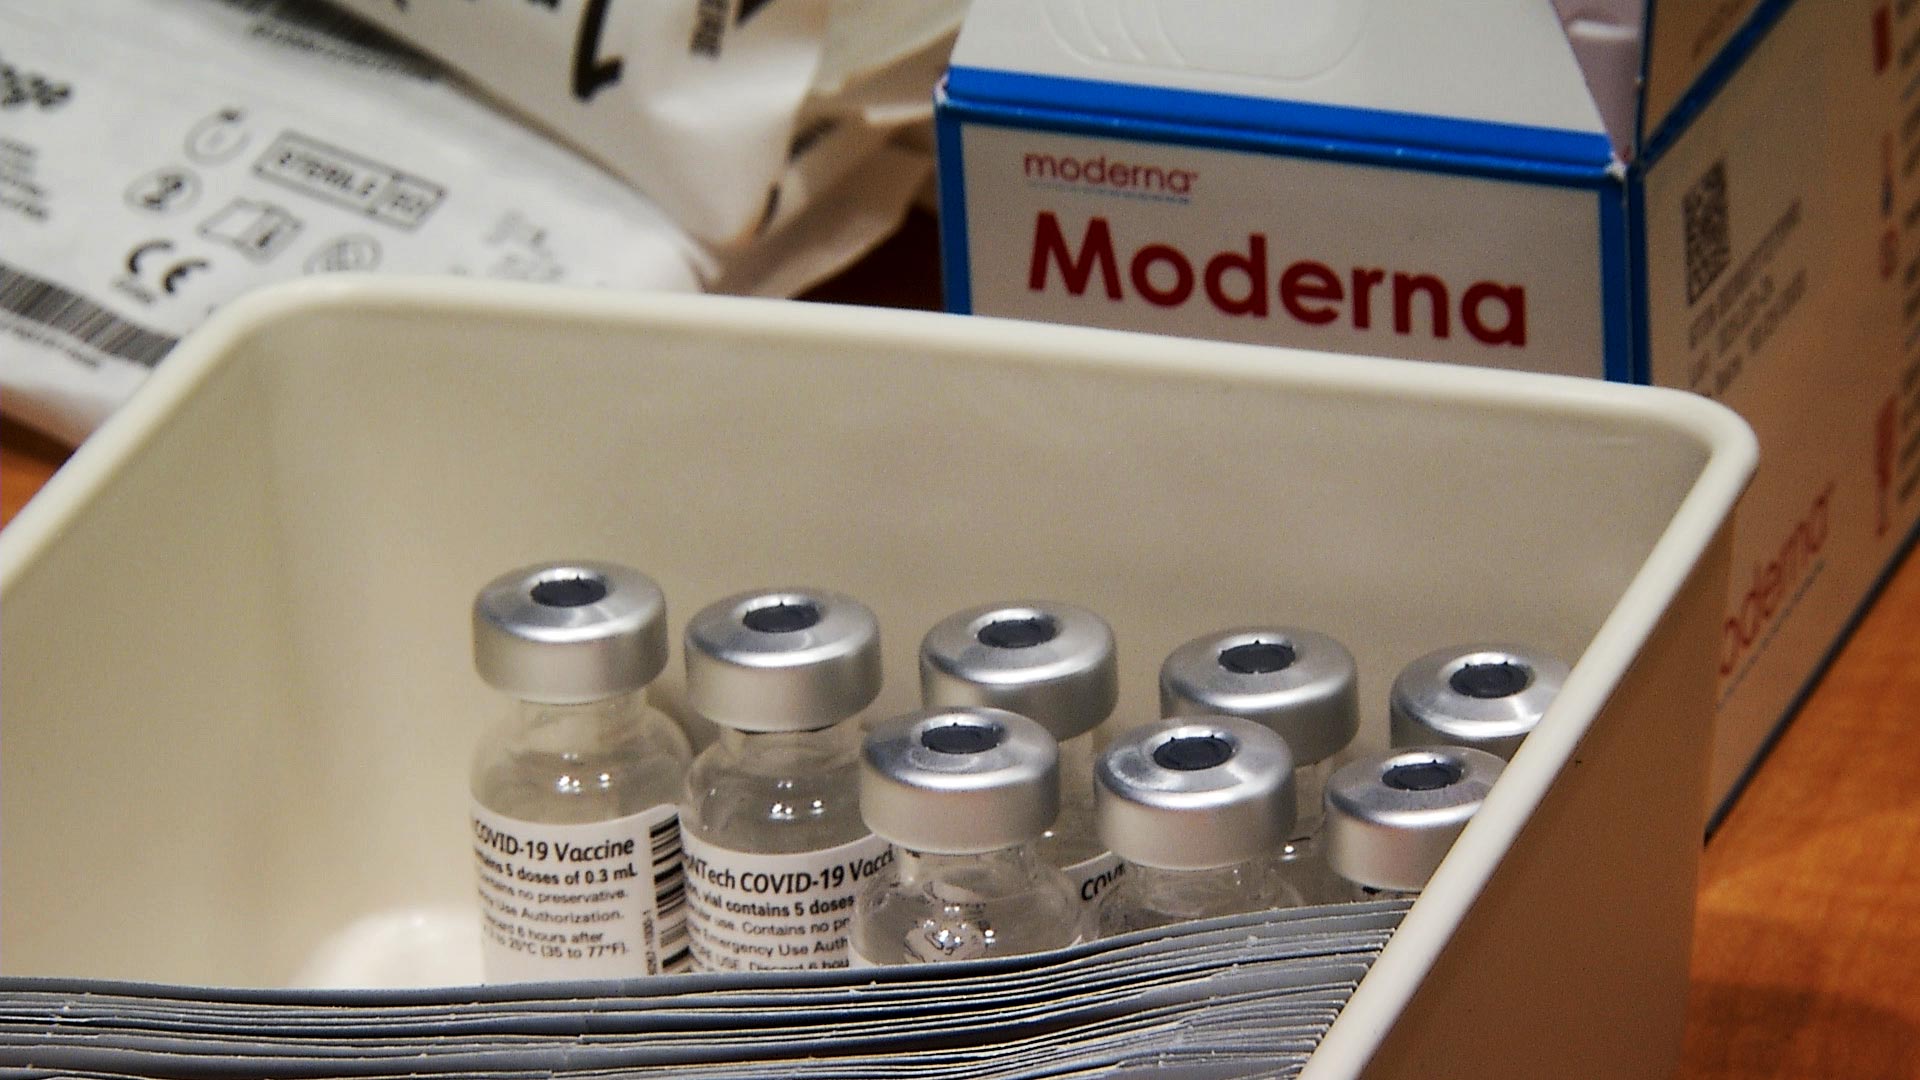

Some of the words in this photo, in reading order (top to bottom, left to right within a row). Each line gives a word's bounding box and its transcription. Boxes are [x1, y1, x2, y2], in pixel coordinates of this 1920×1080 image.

[1023, 152, 1196, 195] moderna
[1028, 209, 1528, 349] Moderna
[554, 838, 635, 862] Vaccine
[505, 863, 514, 878] 5
[517, 867, 559, 885] doses
[564, 870, 579, 886] of
[585, 868, 608, 884] 0.3
[613, 862, 638, 881] mL
[740, 864, 845, 895] COVID-19
[519, 888, 534, 901] no
[538, 889, 629, 904] preservative.
[703, 891, 722, 909] vial
[725, 900, 789, 918] contains
[794, 901, 804, 917] 5
[809, 895, 855, 916] doses
[521, 906, 625, 924] Authorization.
[528, 928, 567, 943] hours
[570, 931, 604, 944] after
[741, 918, 806, 938] Contains
[810, 921, 829, 935] no
[567, 947, 582, 959] to
[777, 943, 809, 958] Use
[813, 936, 849, 954] Auth
